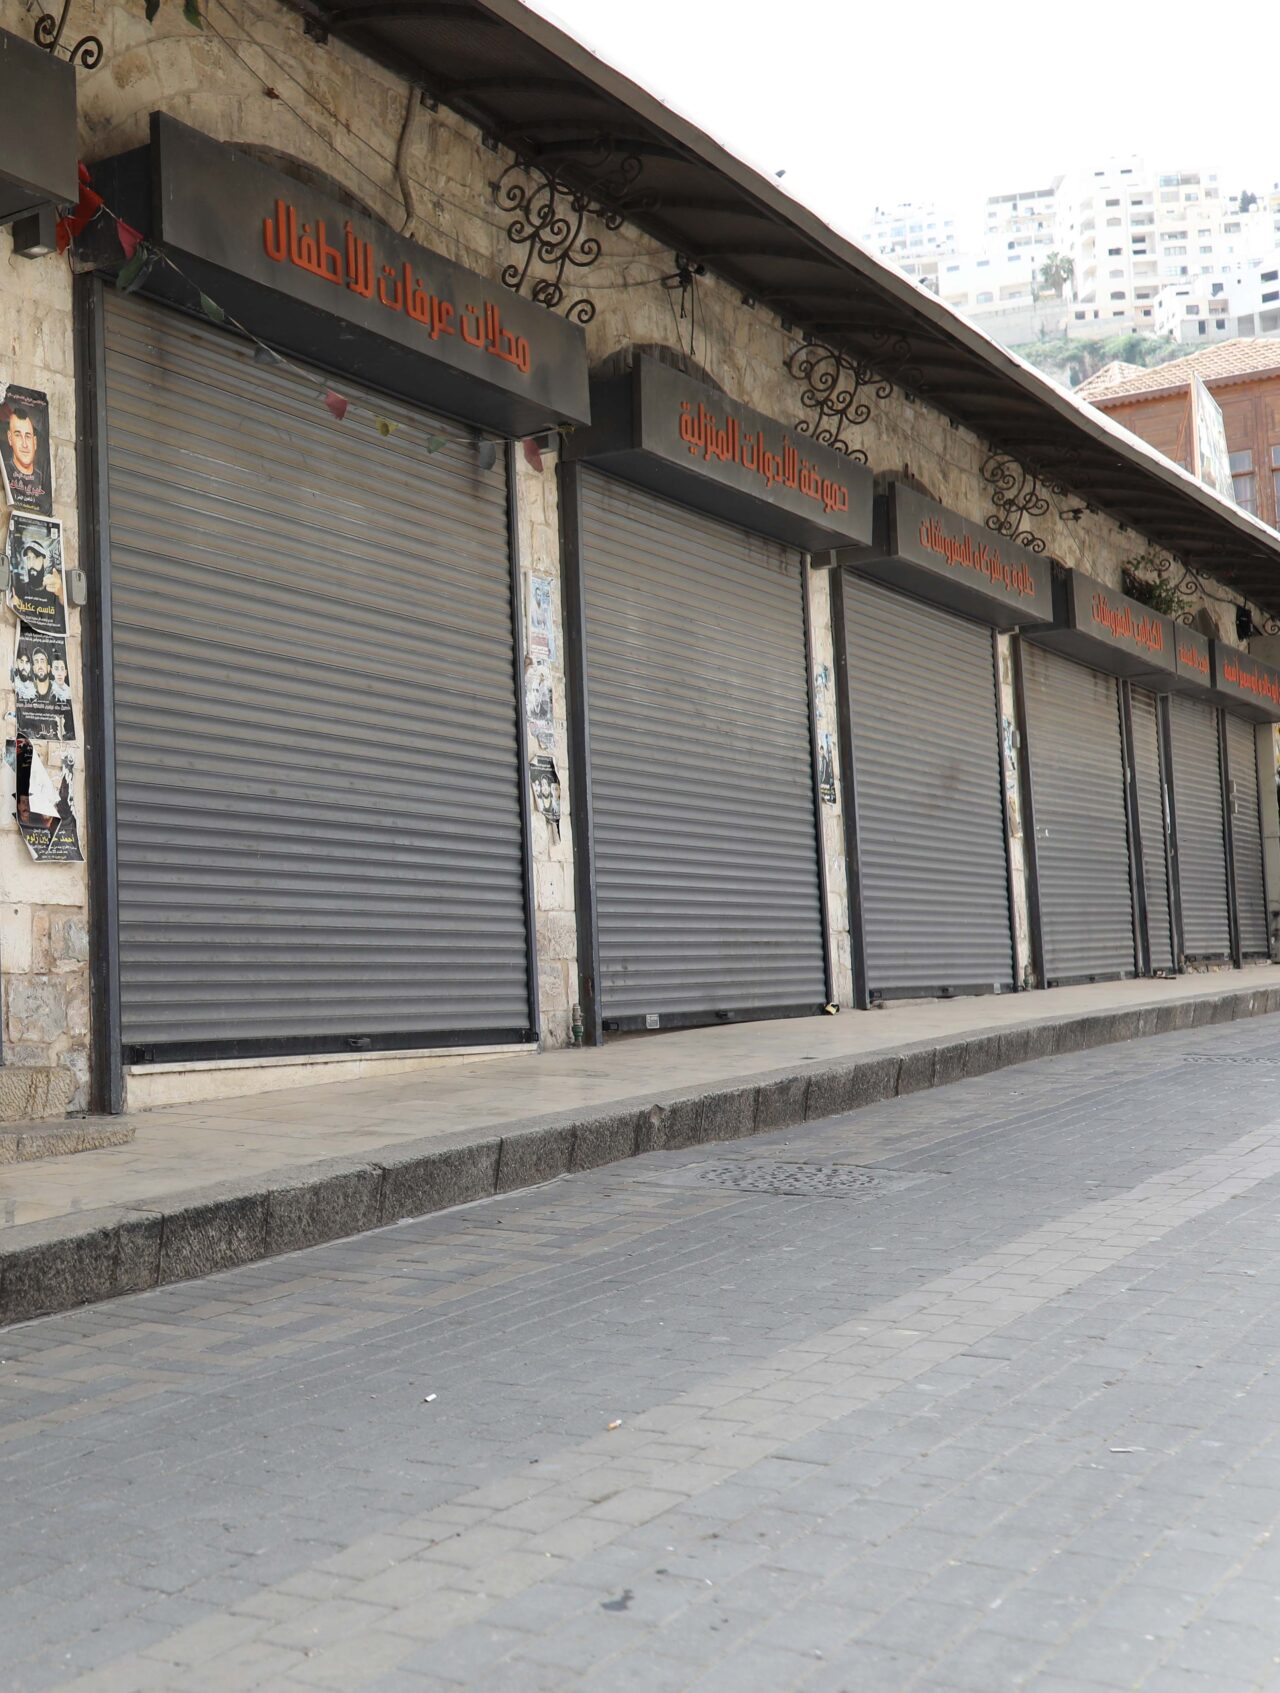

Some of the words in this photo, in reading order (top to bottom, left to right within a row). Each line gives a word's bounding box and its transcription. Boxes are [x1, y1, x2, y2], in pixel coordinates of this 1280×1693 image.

[263, 198, 375, 299] للأطفال
[378, 262, 455, 341] عرفات
[461, 303, 531, 374] محلات
[679, 400, 741, 463] المنزلية
[799, 460, 849, 513] حموضة
